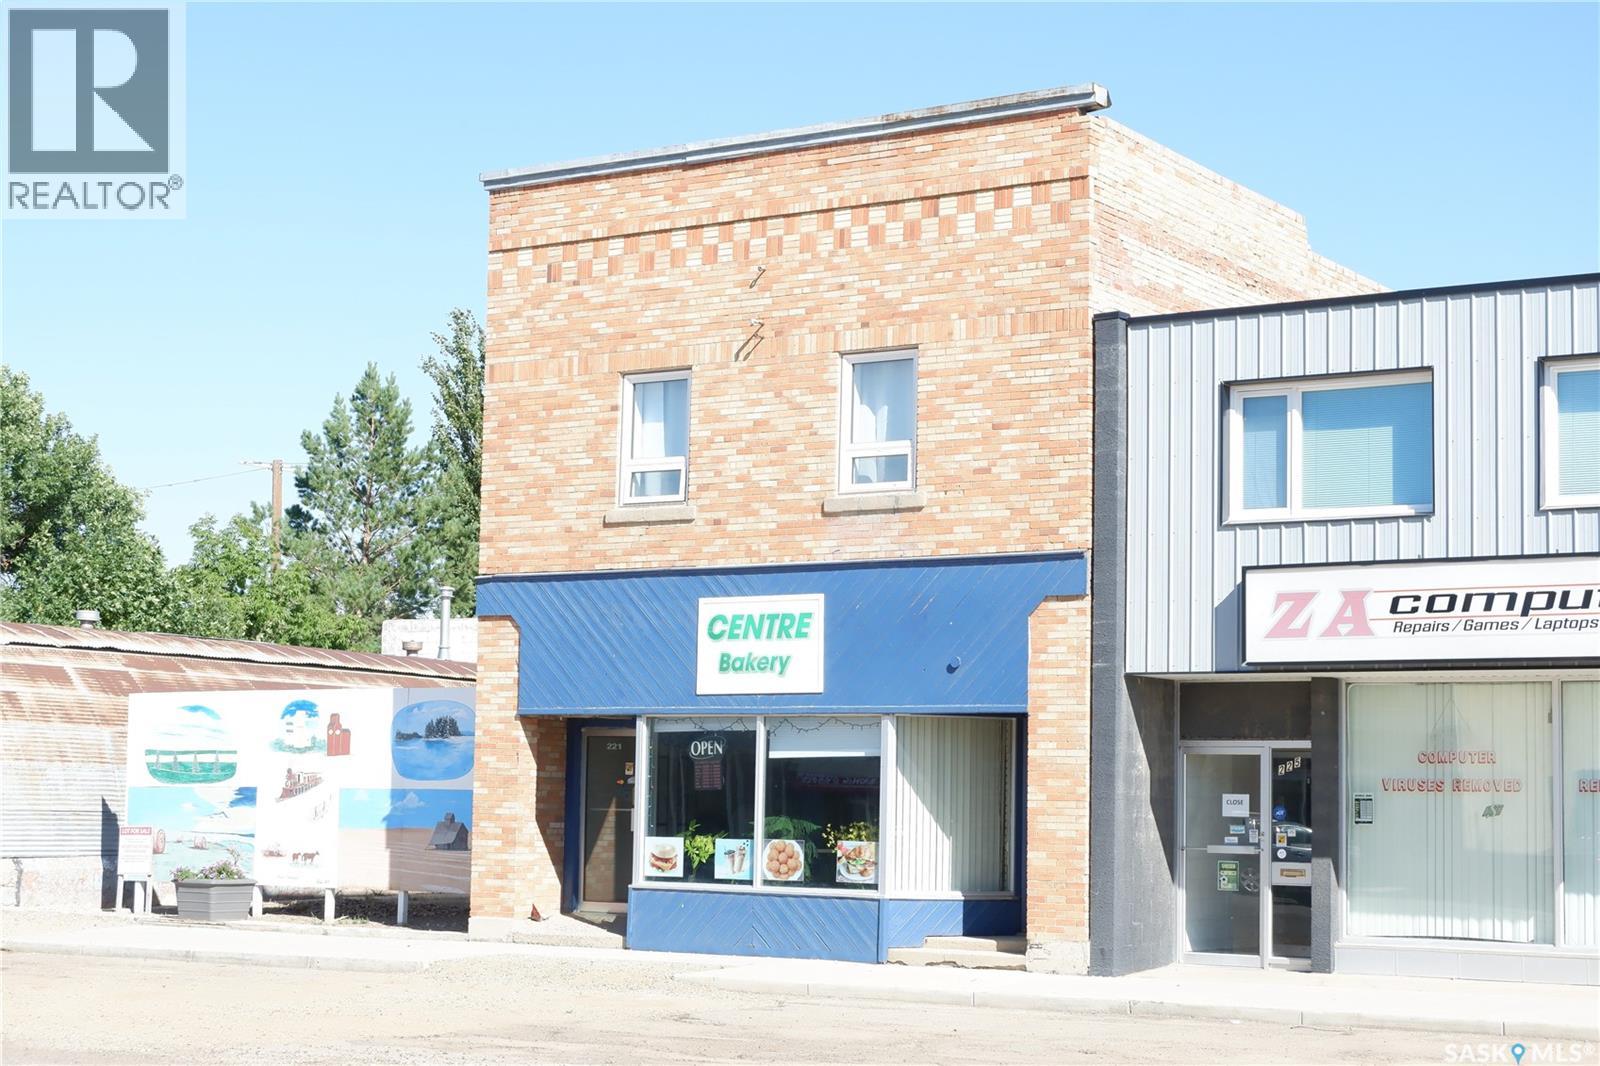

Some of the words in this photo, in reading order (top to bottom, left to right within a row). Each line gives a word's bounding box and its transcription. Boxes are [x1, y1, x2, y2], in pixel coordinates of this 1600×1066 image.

[1389, 589, 1600, 617] compu
[707, 612, 812, 641] CENTRE
[1534, 617, 1599, 632] Laptops
[719, 652, 791, 677] Bakery
[691, 740, 723, 756] OPEN
[1278, 756, 1301, 776] 225
[1418, 751, 1496, 764] COMPUTER
[1382, 778, 1444, 792] VIRUSES
[1452, 778, 1522, 793] REMOVED
